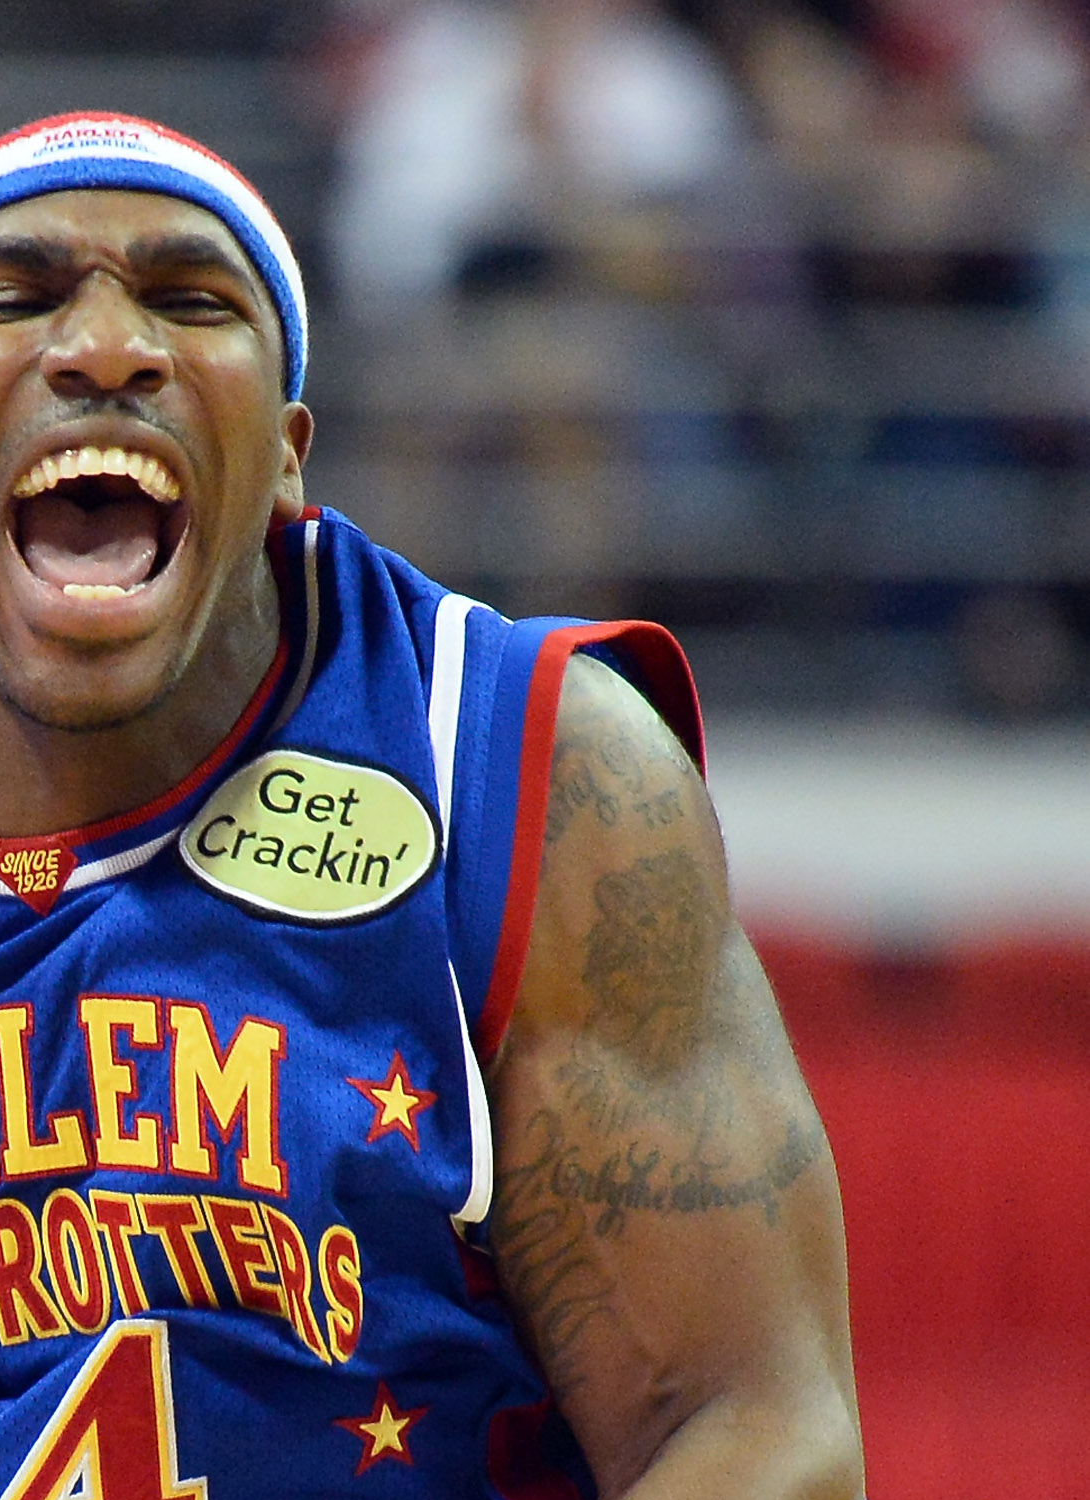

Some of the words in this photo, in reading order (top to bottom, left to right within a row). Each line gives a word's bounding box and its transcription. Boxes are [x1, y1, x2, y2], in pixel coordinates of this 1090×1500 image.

[259, 769, 360, 827] Get
[196, 814, 409, 888] Crackin'
[13, 870, 59, 894] 1926
